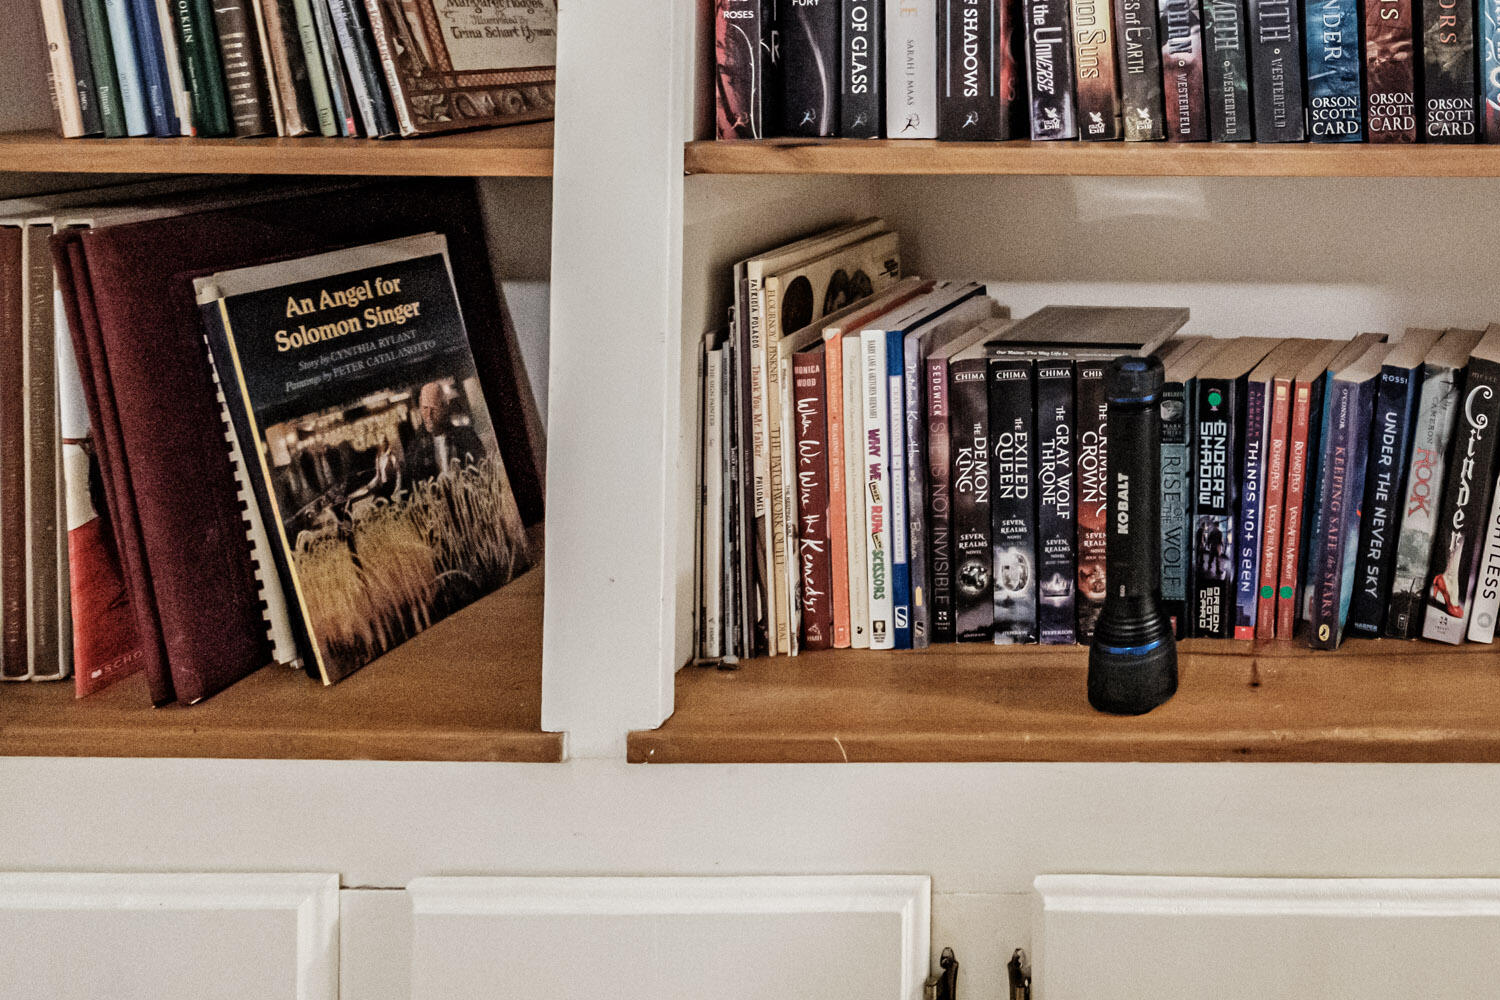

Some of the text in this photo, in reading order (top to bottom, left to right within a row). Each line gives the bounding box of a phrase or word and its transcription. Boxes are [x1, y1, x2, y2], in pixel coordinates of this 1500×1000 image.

[852, 6, 867, 33] OF
[851, 35, 867, 94] GLASS
[963, 10, 978, 97] SHADOWS
[1312, 97, 1357, 107] ORSON
[1312, 121, 1359, 136] CARD
[1313, 108, 1357, 120] SCOTT
[286, 277, 401, 318] An Angel for
[274, 301, 421, 352] Solomon Singer
[955, 373, 985, 381] CHIMA
[1383, 374, 1408, 384] ROSSI
[956, 447, 973, 493] KING
[973, 422, 987, 503] THE DEMON
[995, 432, 1014, 499] QUEEN
[1014, 417, 1028, 499] THE EXILED
[1200, 421, 1214, 506] SHADOW
[1212, 419, 1227, 509] ENDER'S
[1118, 472, 1129, 534] KOBALT
[1364, 411, 1397, 599] UNDER THE NEVER SKY
